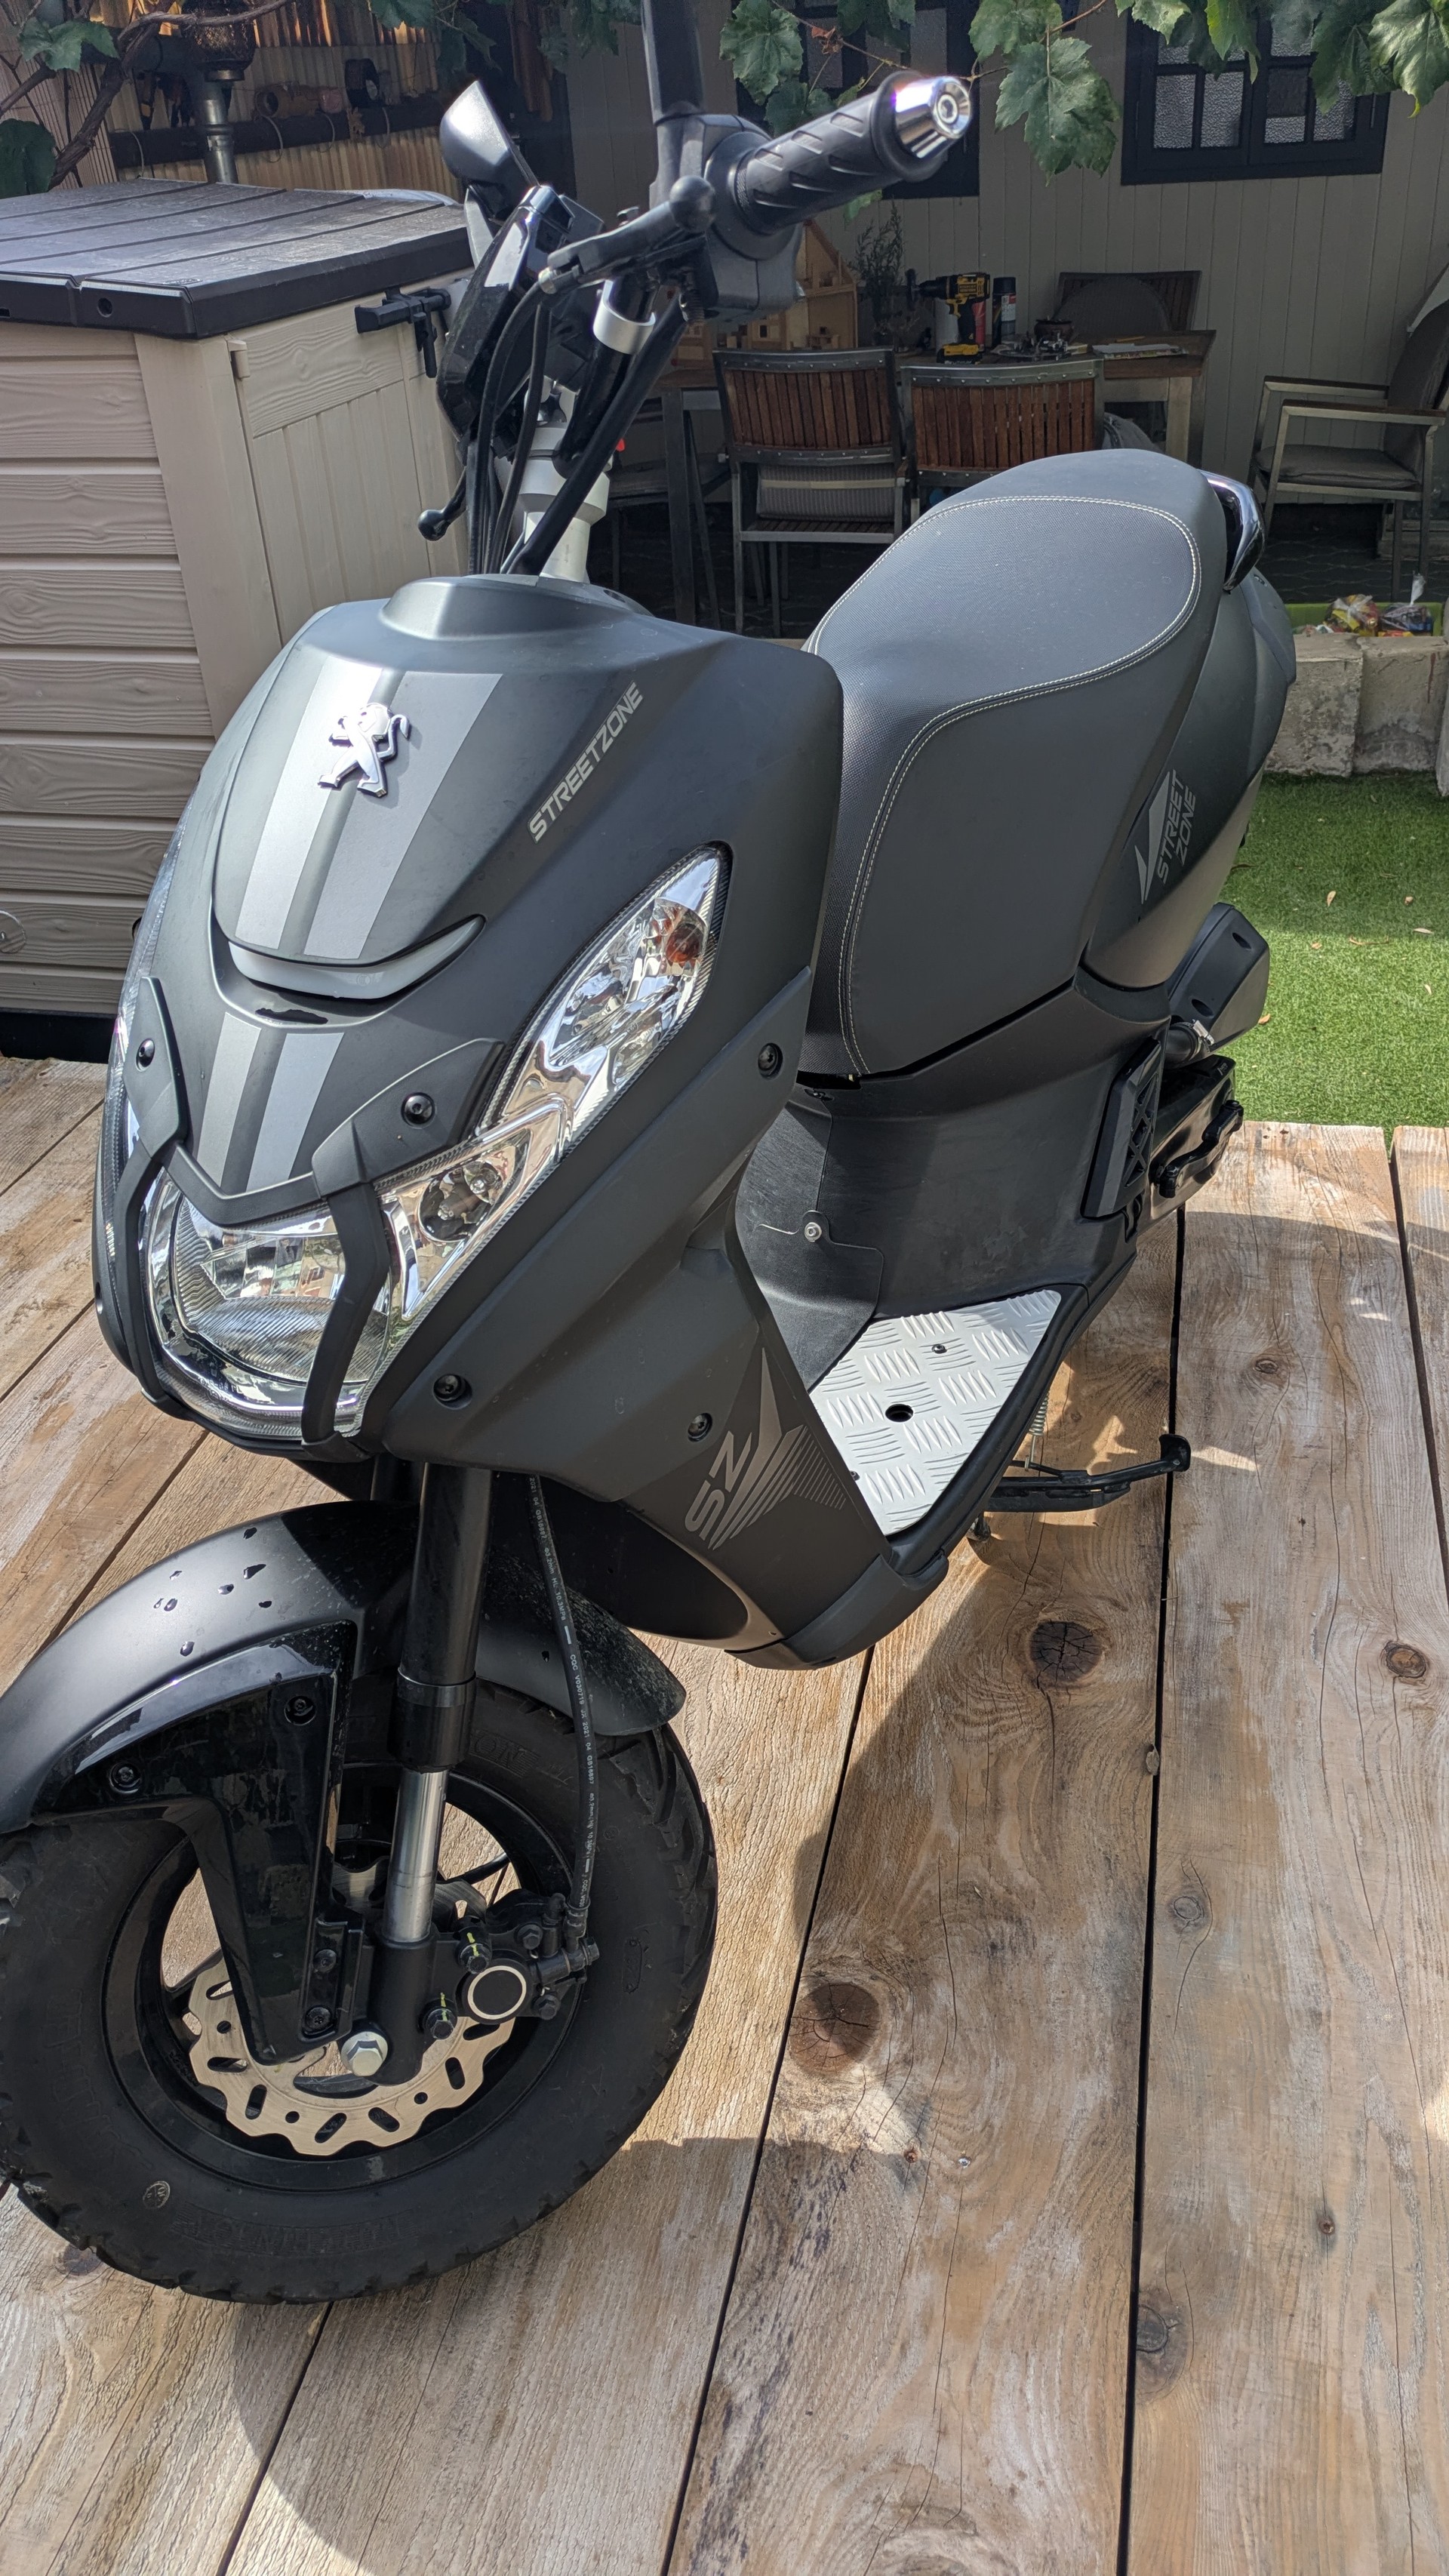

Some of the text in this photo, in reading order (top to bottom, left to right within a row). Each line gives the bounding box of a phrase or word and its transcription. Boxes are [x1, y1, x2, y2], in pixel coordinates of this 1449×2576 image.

[529, 681, 643, 842] STREETZONE
[1158, 769, 1184, 885] STREET
[1175, 786, 1196, 866] ZONE
[529, 1477, 537, 1493] 2021
[533, 1497, 540, 1506] 04
[555, 1592, 567, 1621] 10.3MPa
[570, 1654, 579, 1671] CQC
[582, 1722, 590, 1738] 2021
[586, 1742, 592, 1751] 04
